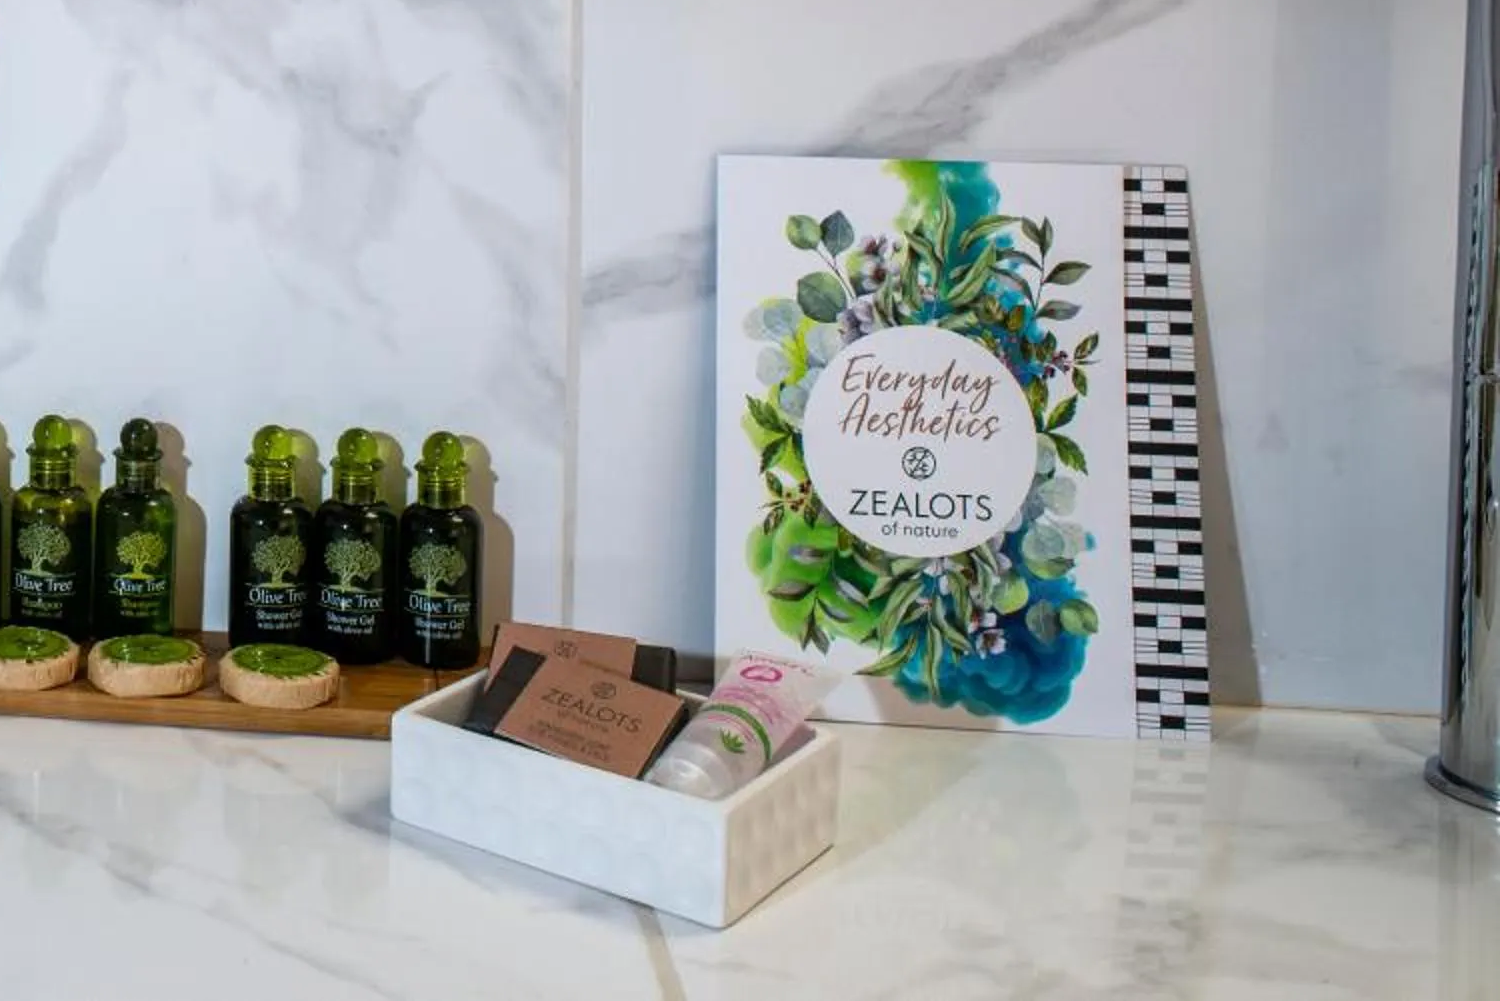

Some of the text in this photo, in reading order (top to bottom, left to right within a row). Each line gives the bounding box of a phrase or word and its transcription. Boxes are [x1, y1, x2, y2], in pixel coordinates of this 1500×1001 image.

[841, 353, 1001, 413] Everyday
[838, 391, 1000, 441] Aesthetics
[848, 489, 993, 522] ZEALOTS
[881, 521, 959, 539] of nature
[15, 572, 74, 592] Olive Tree
[113, 577, 166, 594] Olive Tree
[248, 587, 284, 605] Olive
[320, 588, 353, 610] Olive
[408, 594, 471, 614] Olive Tree
[359, 613, 375, 627] Gel
[449, 618, 466, 631] Gel
[541, 687, 643, 734] ZEALOTS
